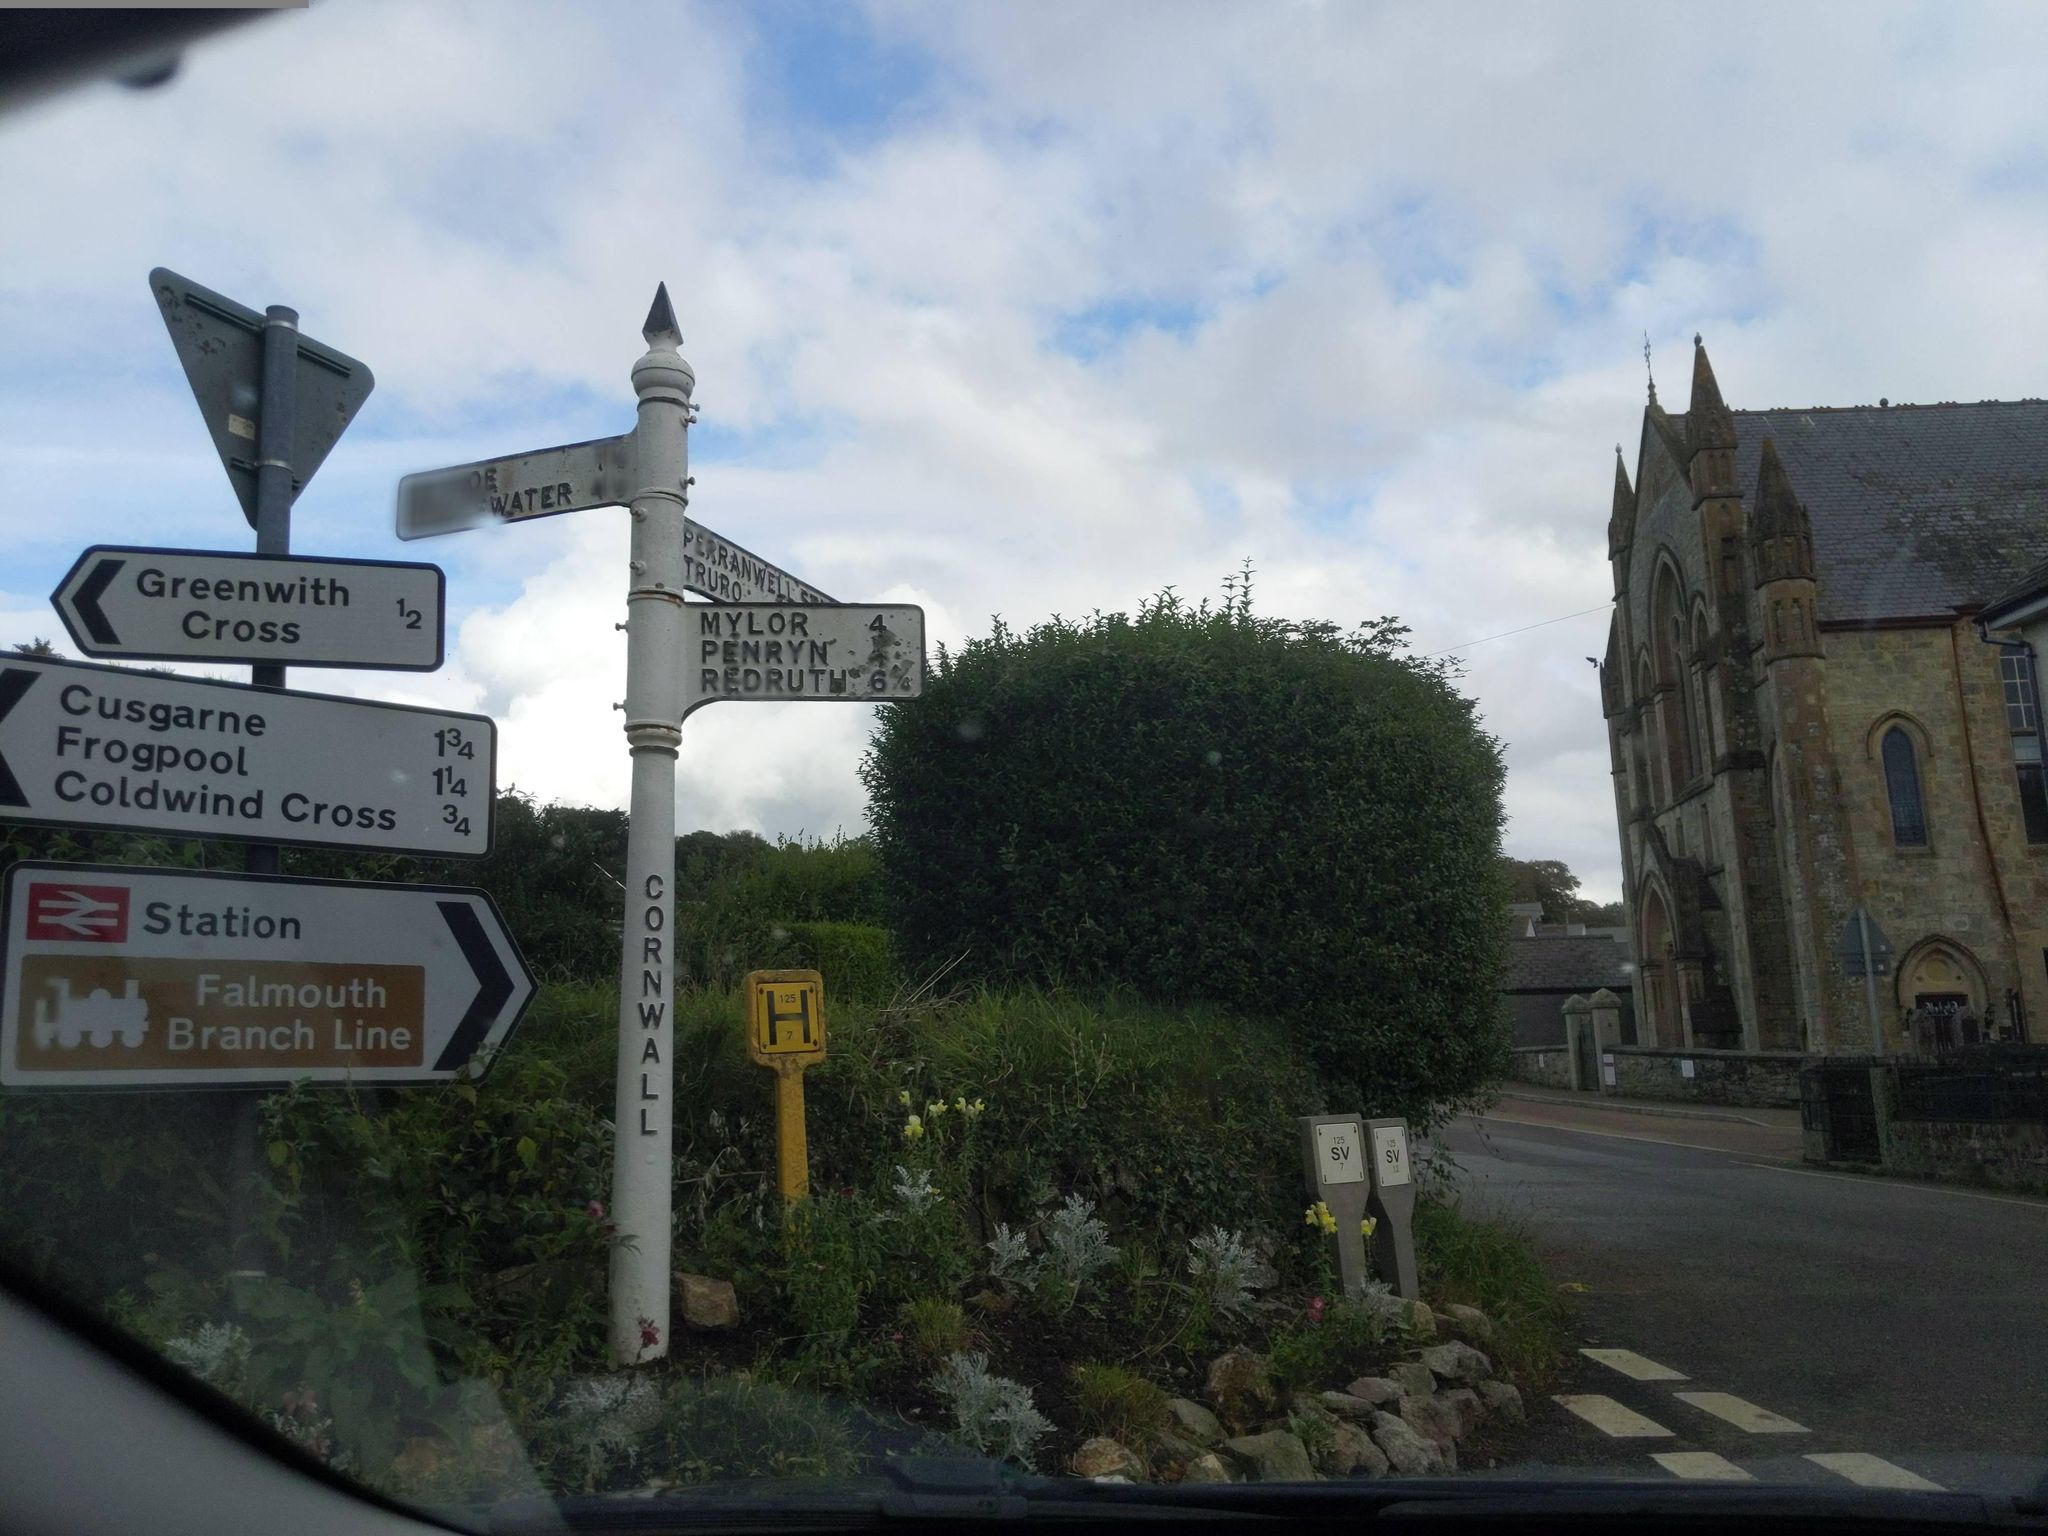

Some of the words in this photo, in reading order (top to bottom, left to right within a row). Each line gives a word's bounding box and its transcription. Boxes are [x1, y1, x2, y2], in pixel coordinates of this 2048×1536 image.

[490, 482, 573, 516] WATER
[137, 569, 349, 606] Greenwith
[683, 554, 742, 601] TRURO
[181, 611, 301, 644] Cross
[700, 612, 809, 636] MYLOR
[701, 640, 829, 665] PENRYN
[701, 668, 846, 693] REDRUTH
[60, 685, 266, 737] Cusgarne
[57, 726, 248, 776] Frogpool
[54, 770, 263, 820] Coldwind
[281, 793, 396, 831] Cross
[143, 902, 301, 940] Station
[197, 974, 386, 1009] Falmouth
[638, 874, 665, 1136] CORNWALL
[779, 994, 796, 1004] 125
[168, 1017, 314, 1051] Branch
[334, 1019, 412, 1051] Line
[767, 990, 811, 1045] H
[786, 1031, 794, 1041] 7
[1331, 1147, 1350, 1161] SV
[1386, 1149, 1400, 1163] SV
